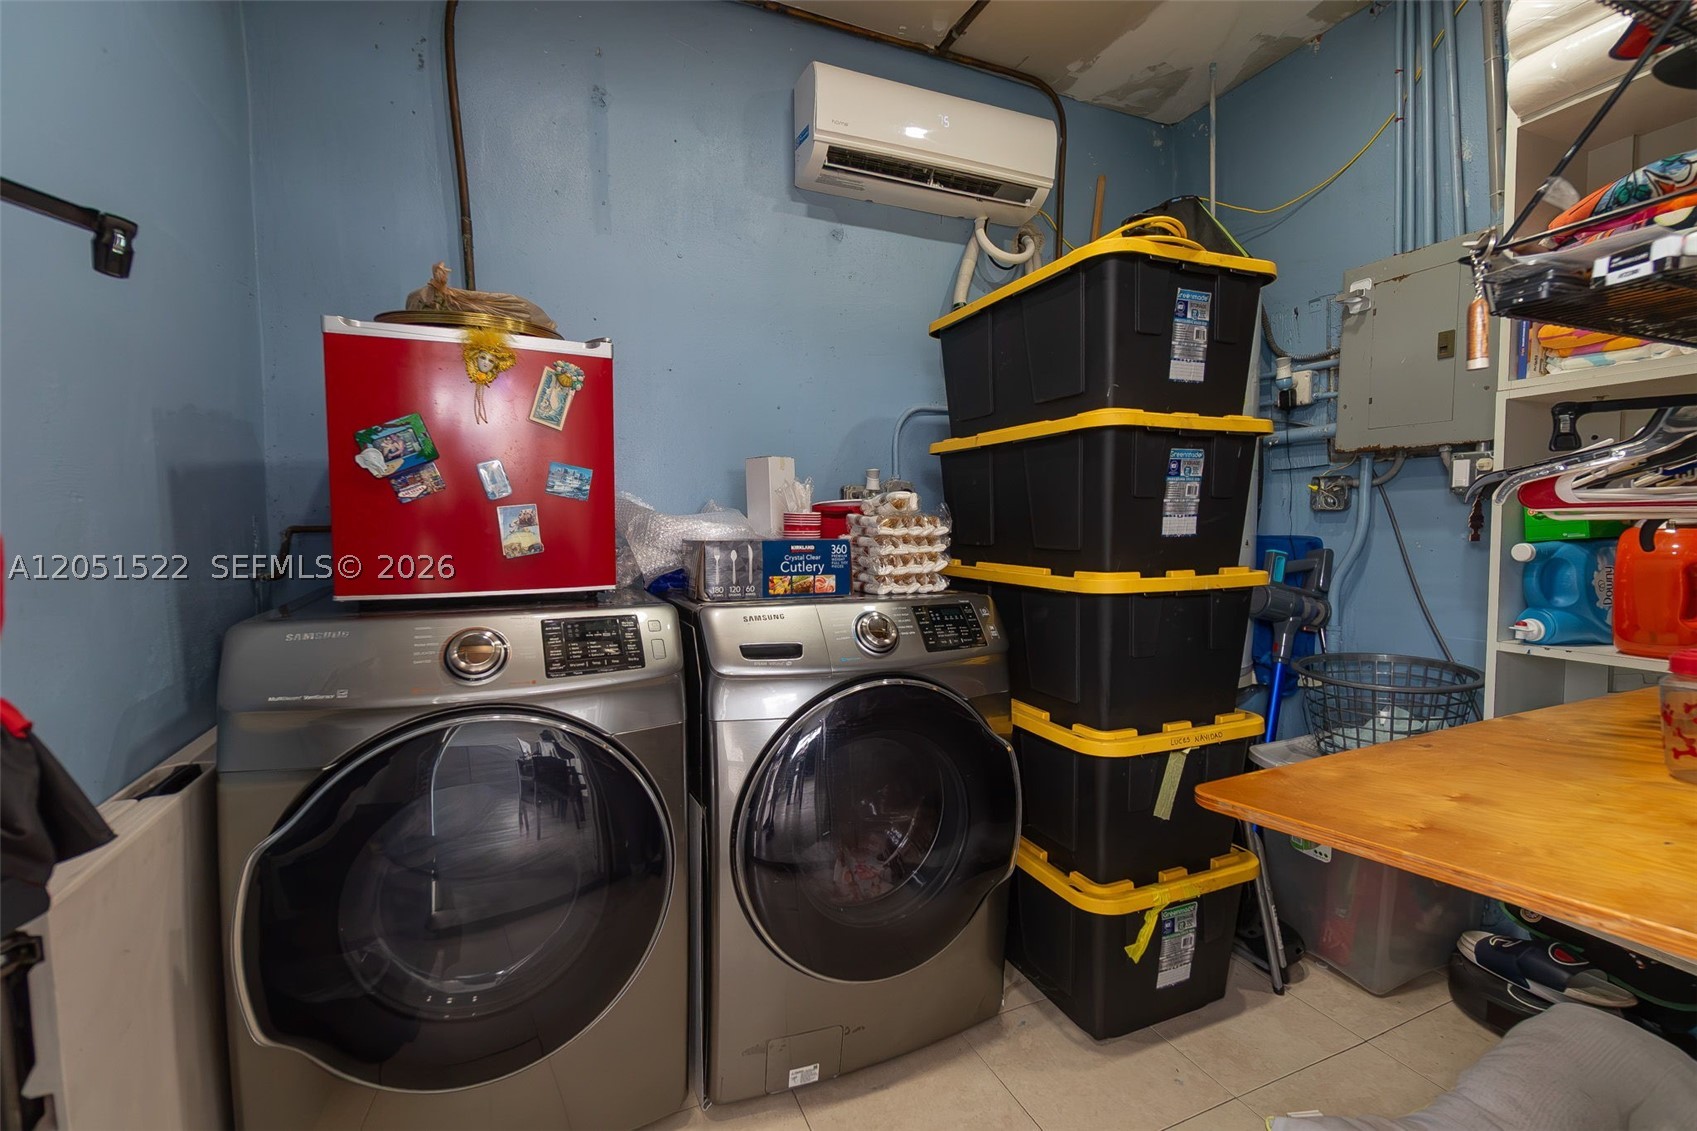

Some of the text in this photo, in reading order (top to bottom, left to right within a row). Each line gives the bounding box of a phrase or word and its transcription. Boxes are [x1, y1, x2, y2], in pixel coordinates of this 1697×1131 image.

[831, 544, 847, 554] 360
[784, 554, 805, 562] Crystal
[780, 561, 825, 575] Cutlery
[712, 586, 724, 594] 180
[745, 585, 755, 593] 60
[1603, 566, 1615, 605] Downy
[743, 613, 785, 623] SAMSUNG
[1170, 731, 1223, 746] LUCES NAVIDAD
